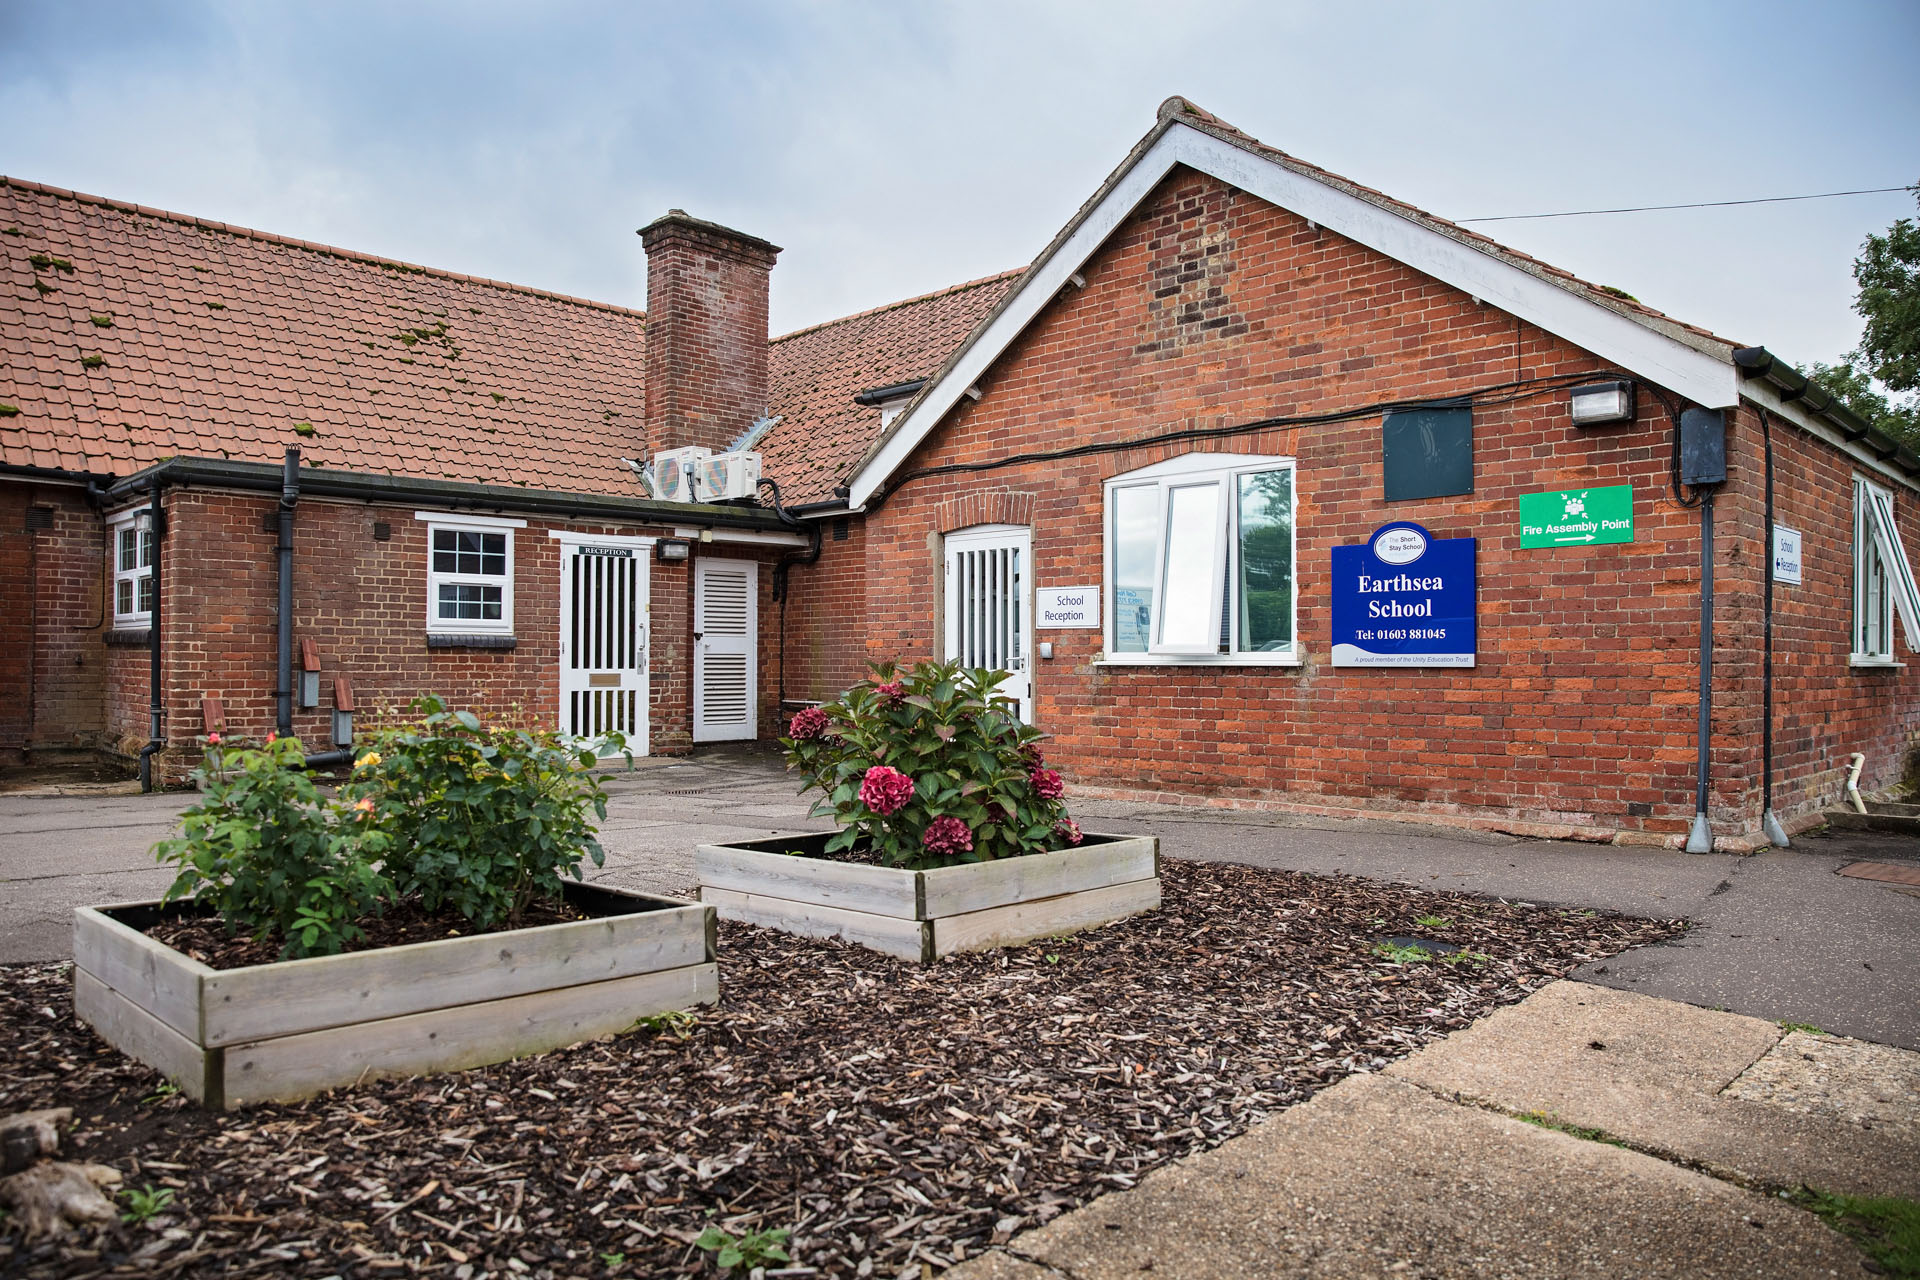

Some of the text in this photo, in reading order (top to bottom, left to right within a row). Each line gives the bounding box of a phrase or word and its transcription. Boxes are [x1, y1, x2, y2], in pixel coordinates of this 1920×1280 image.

[1523, 519, 1630, 535] Fire Assembly Point
[585, 547, 627, 556] RECEPTION
[1780, 538, 1794, 553] School
[1780, 557, 1799, 575] Reception
[1357, 573, 1444, 593] Earthsea
[1057, 595, 1084, 606] School
[1368, 598, 1433, 618] School
[1044, 610, 1084, 622] Reception
[1356, 628, 1446, 640] Tel: 01603 881045
